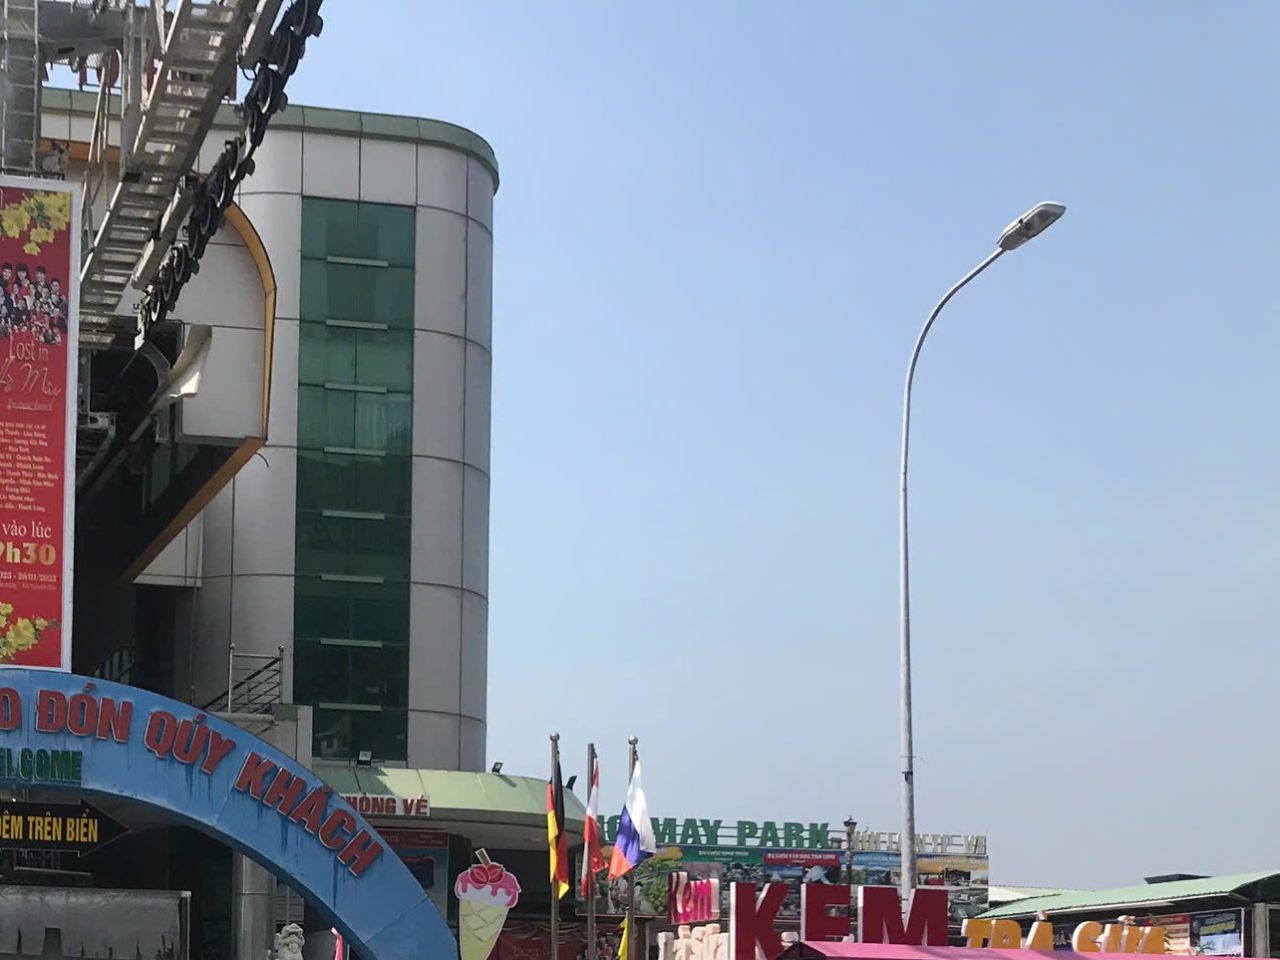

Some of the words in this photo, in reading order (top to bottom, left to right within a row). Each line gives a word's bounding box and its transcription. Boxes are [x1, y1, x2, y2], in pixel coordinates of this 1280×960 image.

[2, 522, 27, 537] vào
[32, 521, 52, 538] lúc
[34, 683, 134, 743] ĐÓN
[234, 751, 385, 877] KHÁCH
[403, 795, 429, 816] VÉ
[27, 811, 63, 842] TRÊN
[650, 817, 723, 846] MAY
[737, 820, 830, 849] PARK
